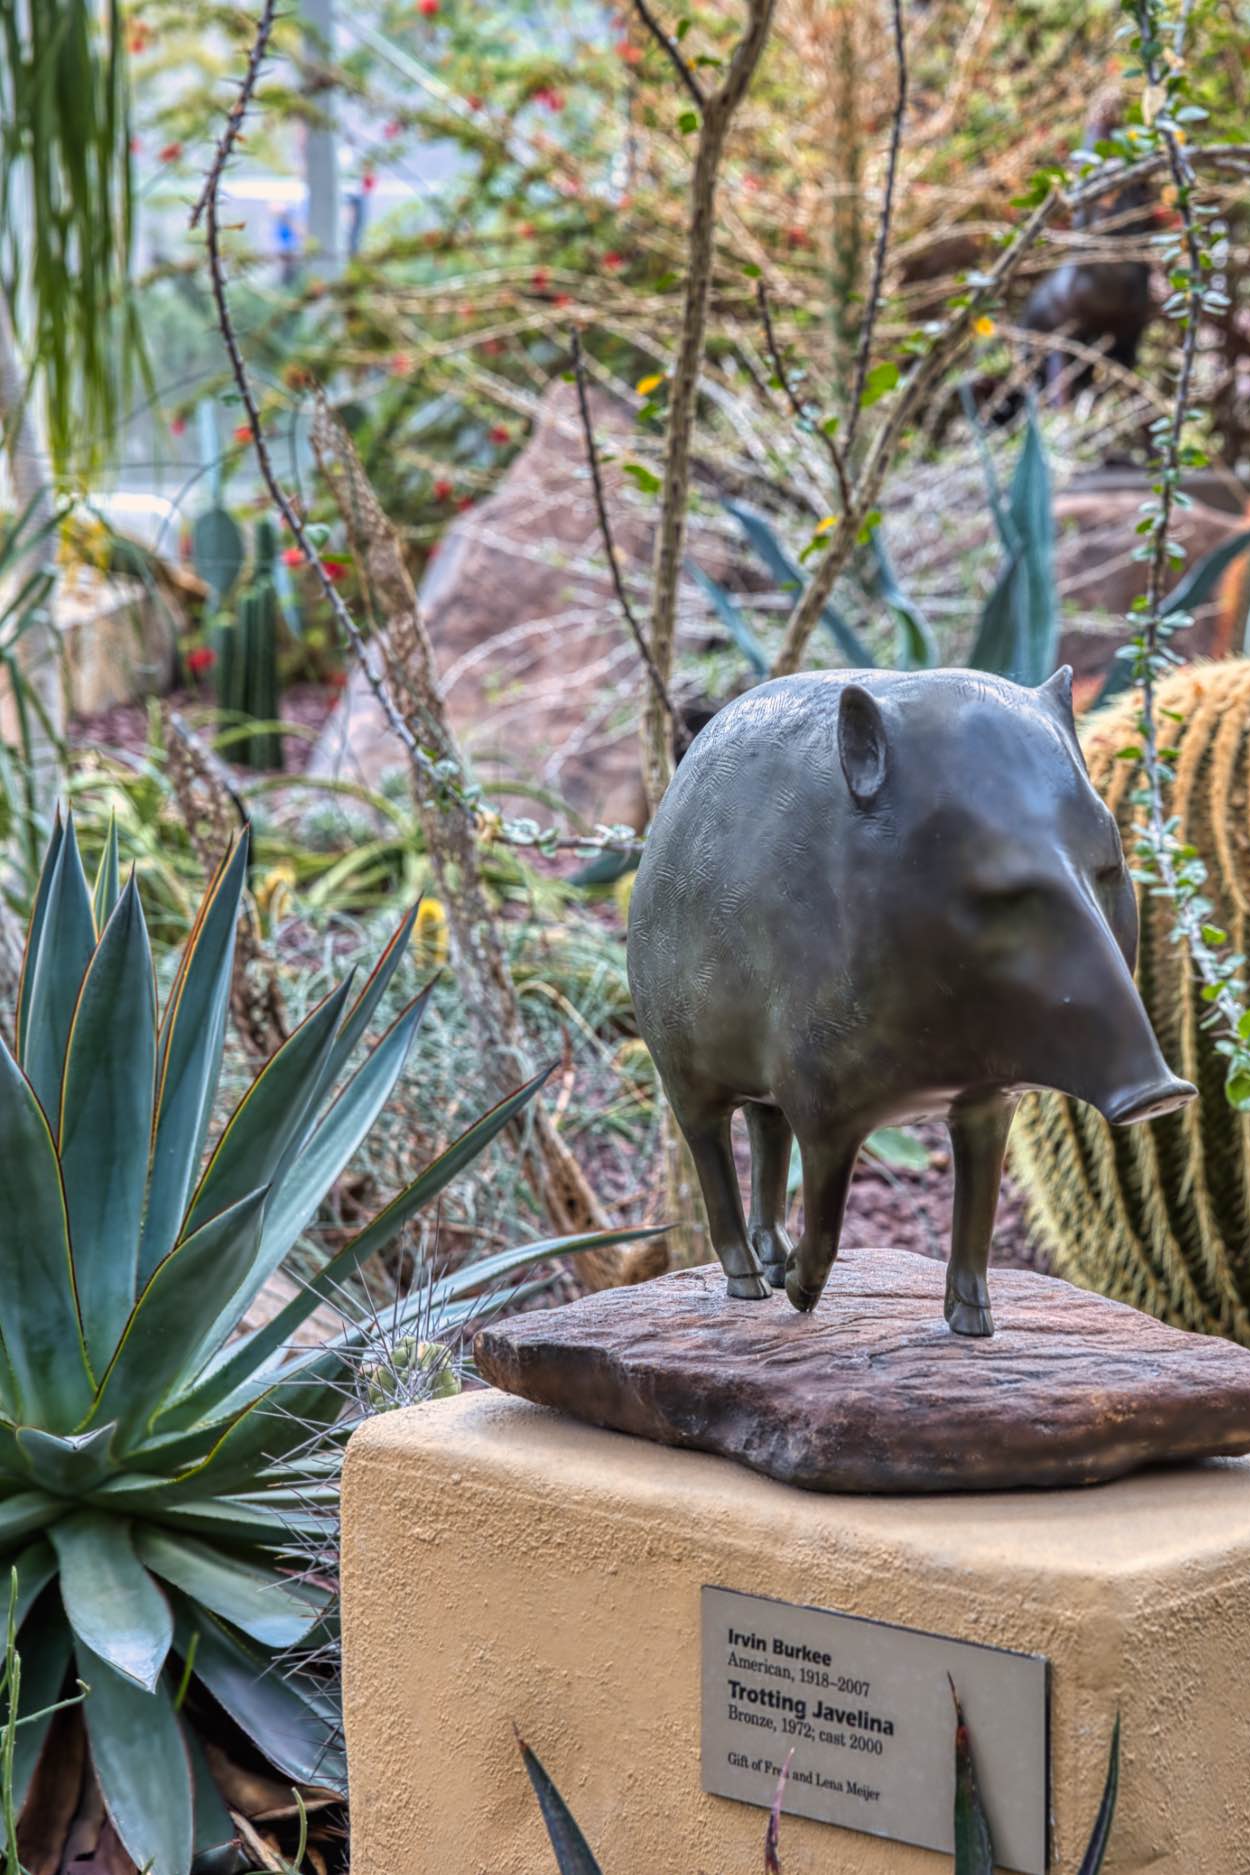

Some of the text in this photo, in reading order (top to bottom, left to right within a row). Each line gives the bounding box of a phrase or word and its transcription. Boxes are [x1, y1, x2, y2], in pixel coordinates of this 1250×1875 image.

[728, 1629, 832, 1666] Irvin Burkee
[728, 1652, 795, 1682] American,
[728, 1681, 894, 1736] Trotting Javelina
[728, 1704, 883, 1756] Bronze, 1972; cast 2000
[728, 1752, 749, 1769] Gift
[751, 1759, 762, 1771] of
[793, 1771, 813, 1784] and
[816, 1773, 843, 1792] Lena
[846, 1780, 880, 1801] Meijer
